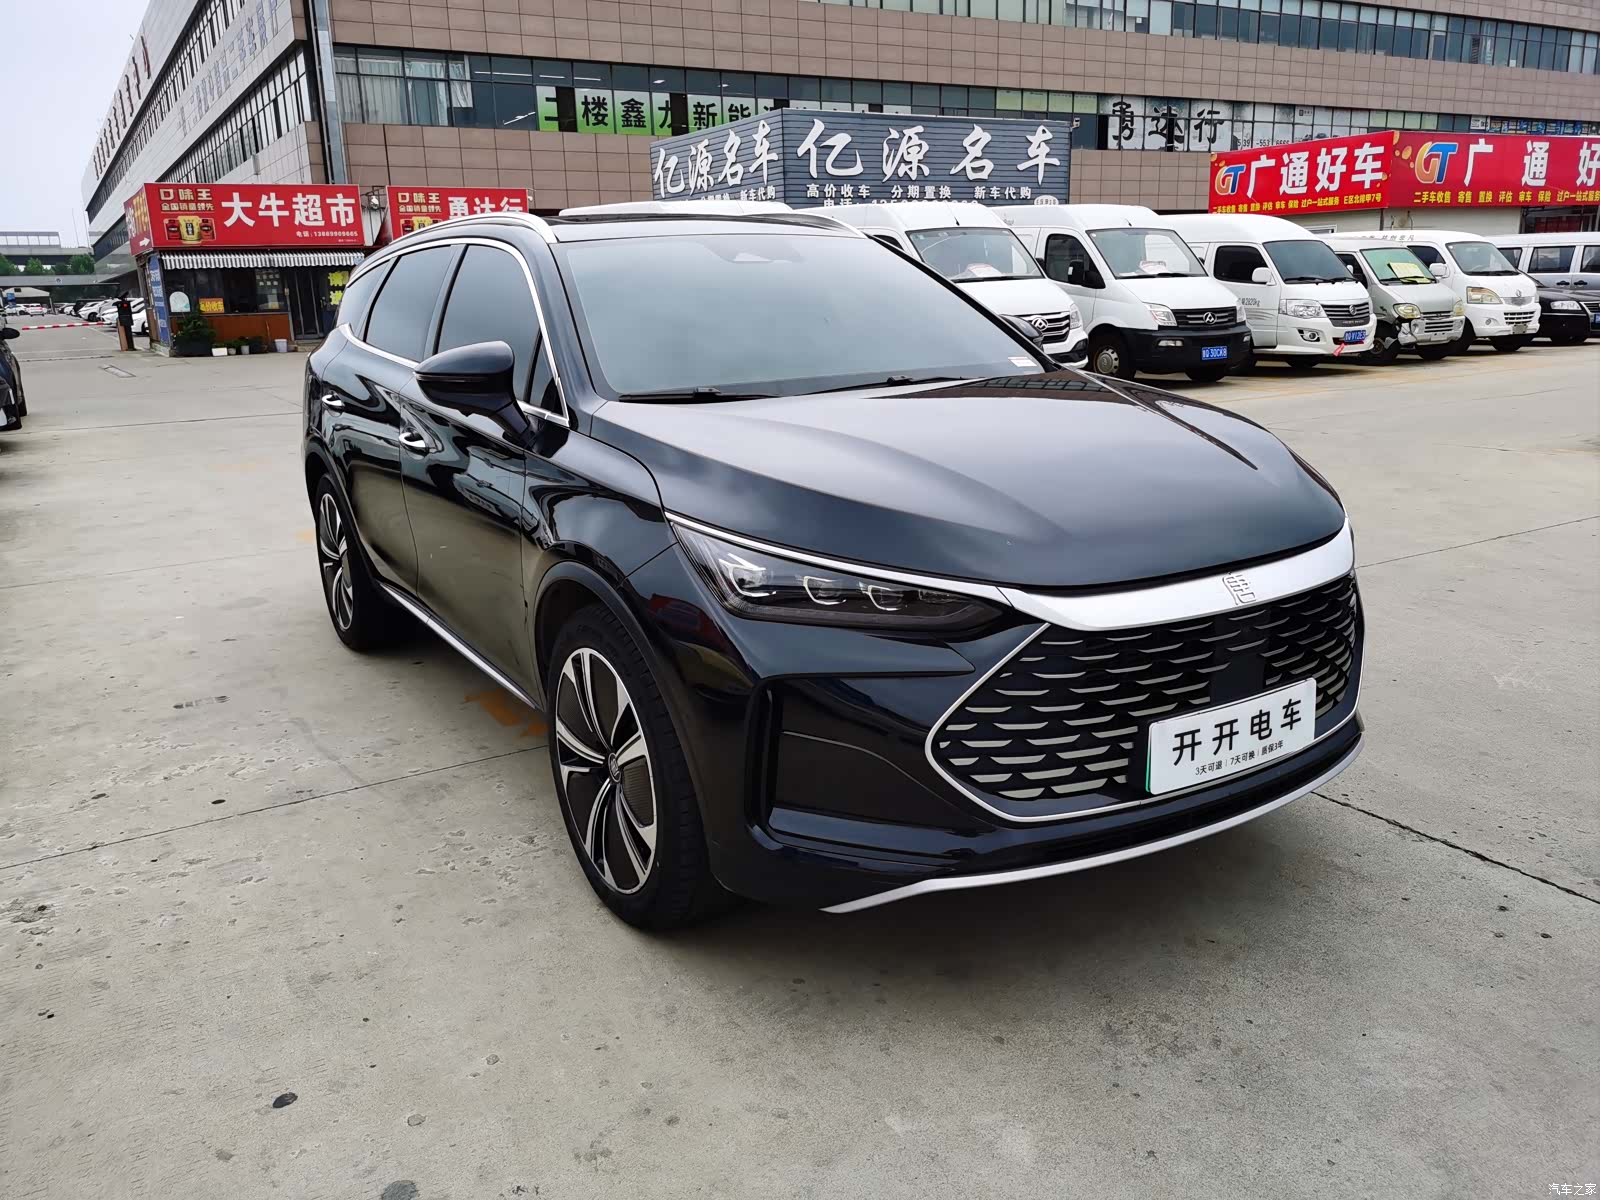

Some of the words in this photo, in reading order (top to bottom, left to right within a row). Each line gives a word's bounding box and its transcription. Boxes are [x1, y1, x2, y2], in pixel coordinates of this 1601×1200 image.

[1111, 101, 1224, 145] 勇达行
[654, 120, 779, 198] 亿源名车
[797, 118, 1061, 185] 亿源名车
[1215, 164, 1246, 196] GT
[1247, 142, 1385, 198] 广通好车
[1415, 141, 1458, 184] GT
[159, 188, 213, 200] 口味王
[161, 202, 215, 211] 全国销量领先
[221, 192, 356, 228] 大牛超市
[398, 192, 441, 203] 口味王
[806, 184, 871, 198] 高价收车
[891, 185, 951, 199] 分期置换
[974, 186, 1032, 199] 新车代购
[1414, 191, 1451, 204] 二手车收售
[1478, 191, 1493, 203] 置换
[1499, 191, 1513, 203] 评估
[1519, 191, 1533, 203] 审车
[1538, 191, 1552, 203] 保险
[1172, 698, 1303, 767] 开开电车
[1195, 760, 1223, 776] 3天可退
[1230, 748, 1256, 766] 7天可换
[1261, 739, 1285, 757] 质保3年
